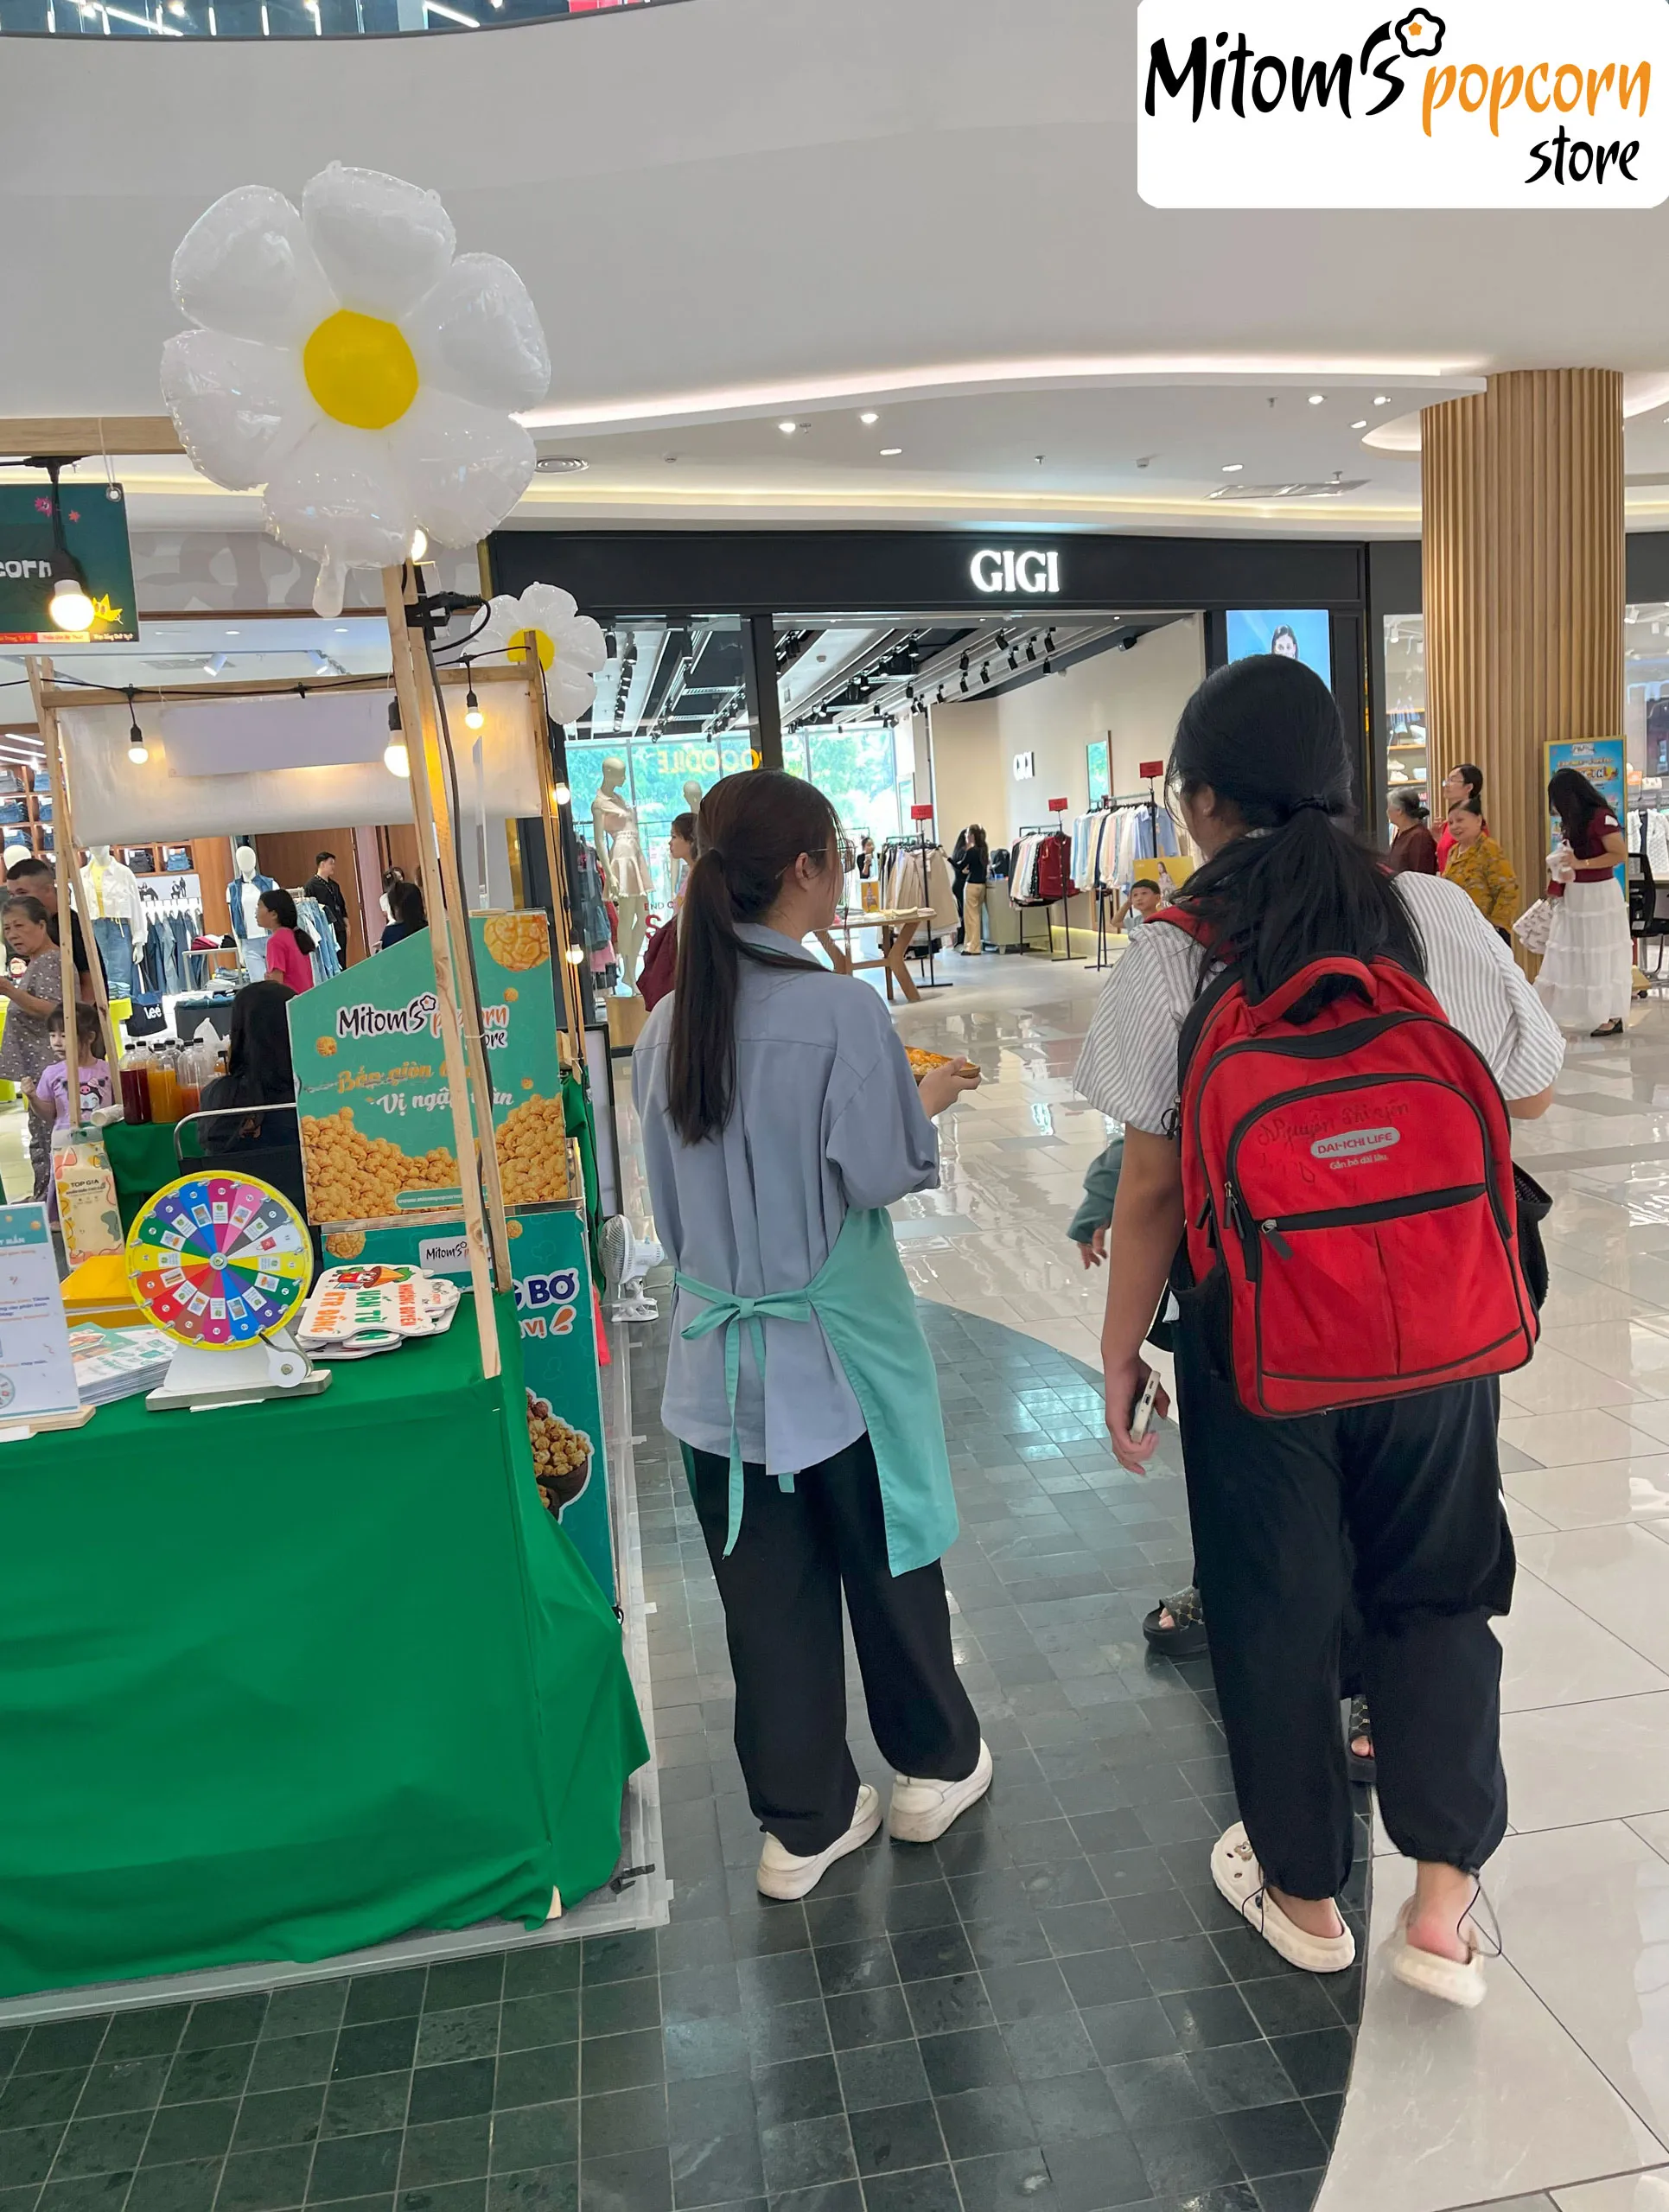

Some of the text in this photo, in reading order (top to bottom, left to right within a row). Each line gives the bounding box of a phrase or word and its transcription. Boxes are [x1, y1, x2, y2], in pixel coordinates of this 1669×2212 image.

[970, 550, 1061, 592] GIGI
[412, 1087, 452, 1112] ngậ
[1317, 1132, 1393, 1154] DAI-ICHI LIFE
[528, 1272, 575, 1305] BƠ
